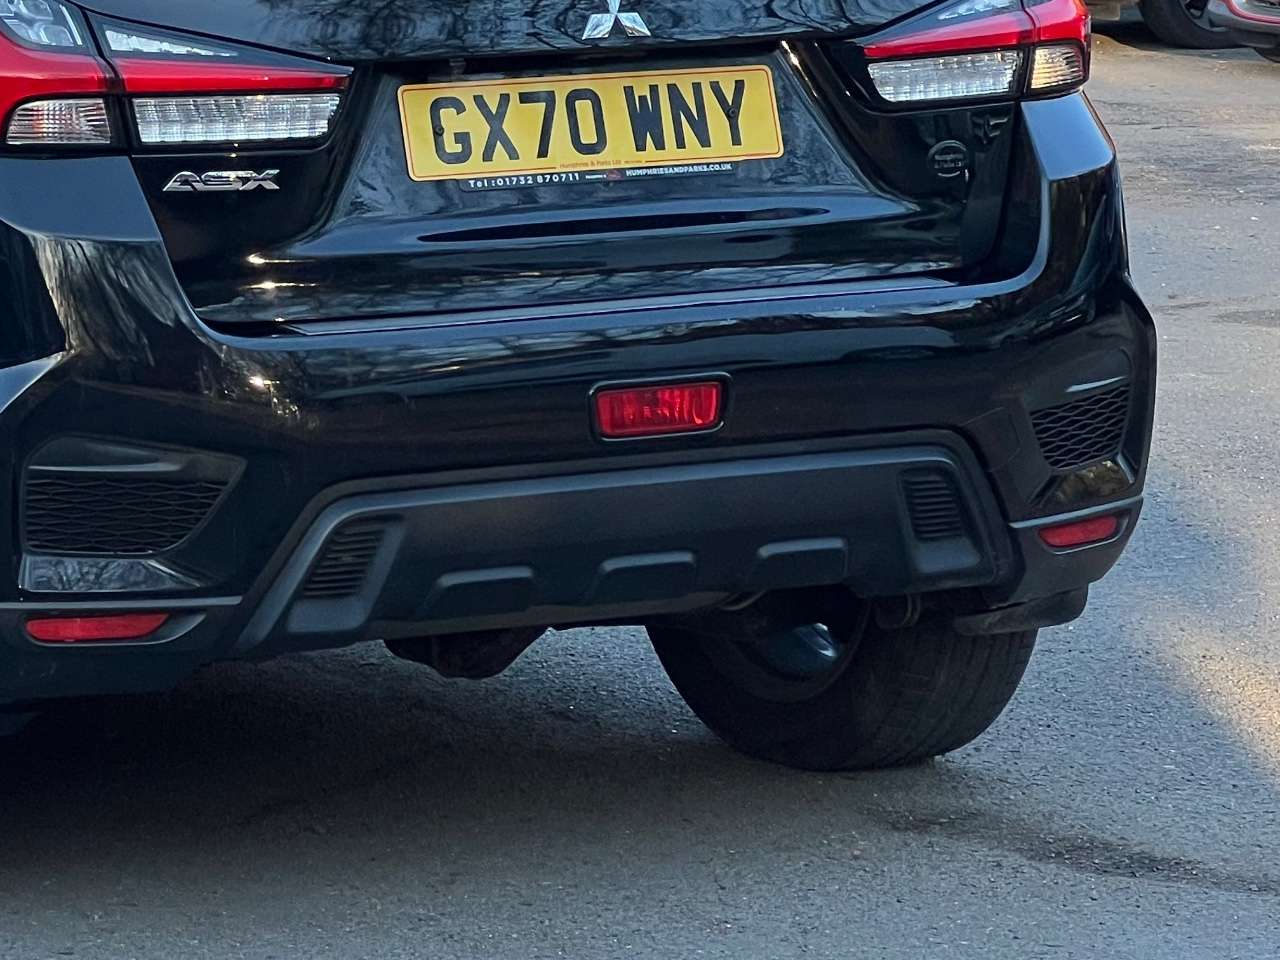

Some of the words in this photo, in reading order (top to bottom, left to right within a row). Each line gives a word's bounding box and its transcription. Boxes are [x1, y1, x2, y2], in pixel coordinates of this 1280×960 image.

[428, 87, 608, 165] GX70
[622, 79, 746, 153] WNY
[162, 169, 281, 192] ASX
[536, 172, 580, 184] 870711
[625, 162, 733, 177] HUMPHRIESANDPARKS.CO.UK
